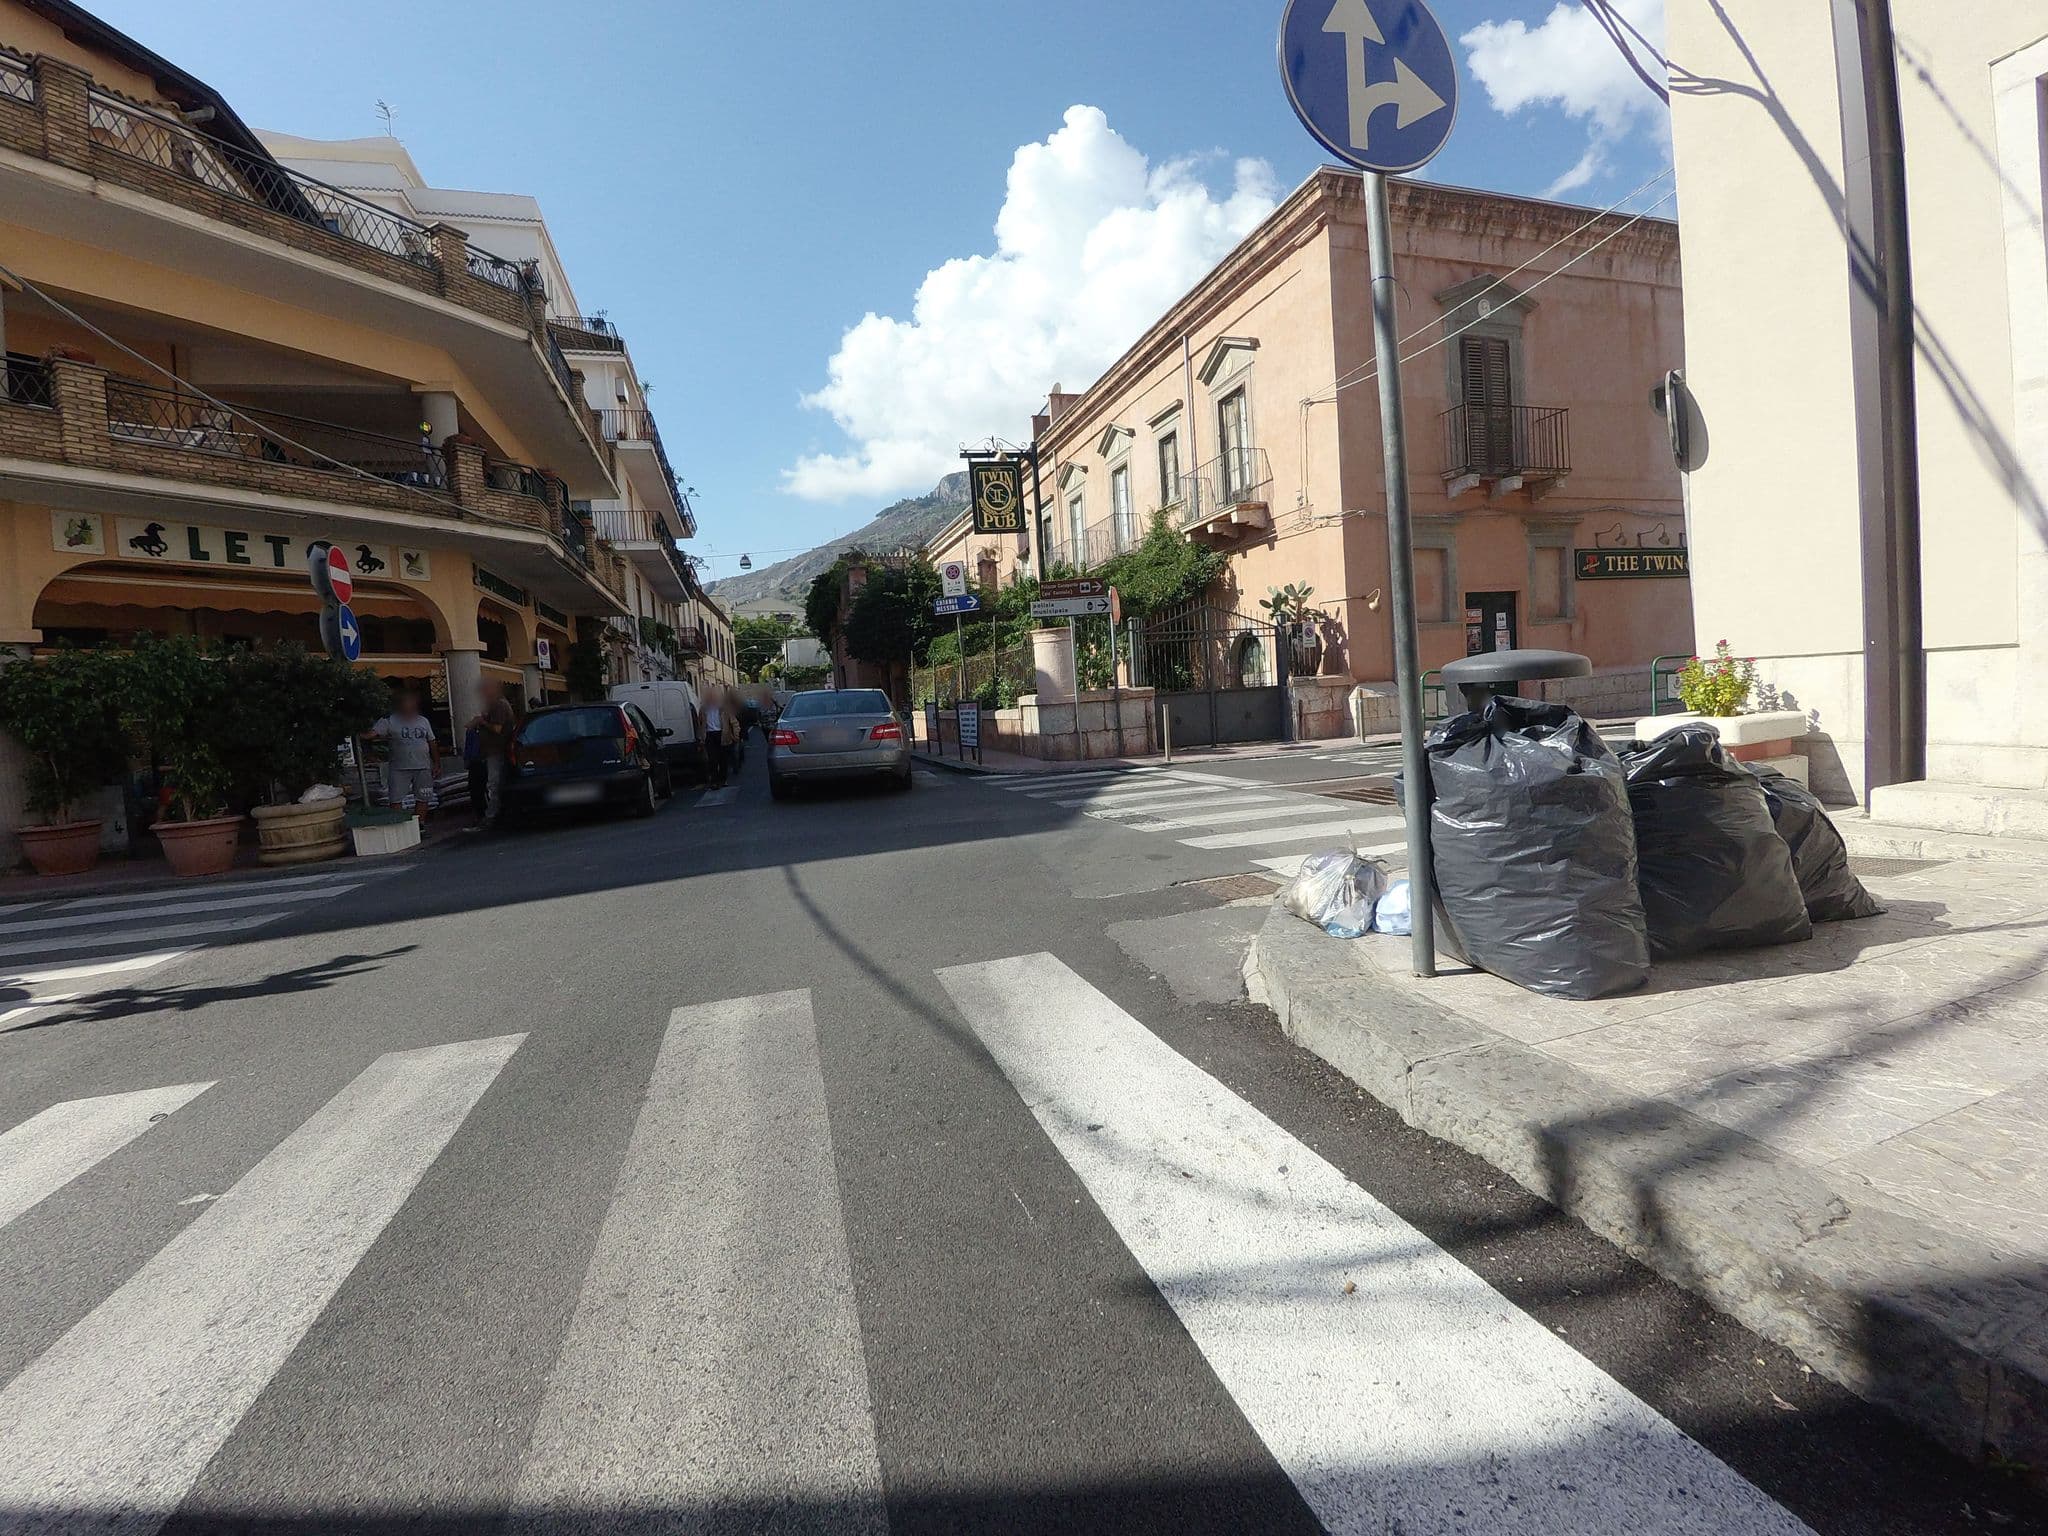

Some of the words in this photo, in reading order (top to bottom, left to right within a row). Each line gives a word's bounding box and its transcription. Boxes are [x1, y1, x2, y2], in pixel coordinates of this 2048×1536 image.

[979, 471, 1013, 491] TWIN
[983, 512, 1016, 528] PUB
[1605, 556, 1639, 571] THE
[1643, 555, 1684, 570] TWIN
